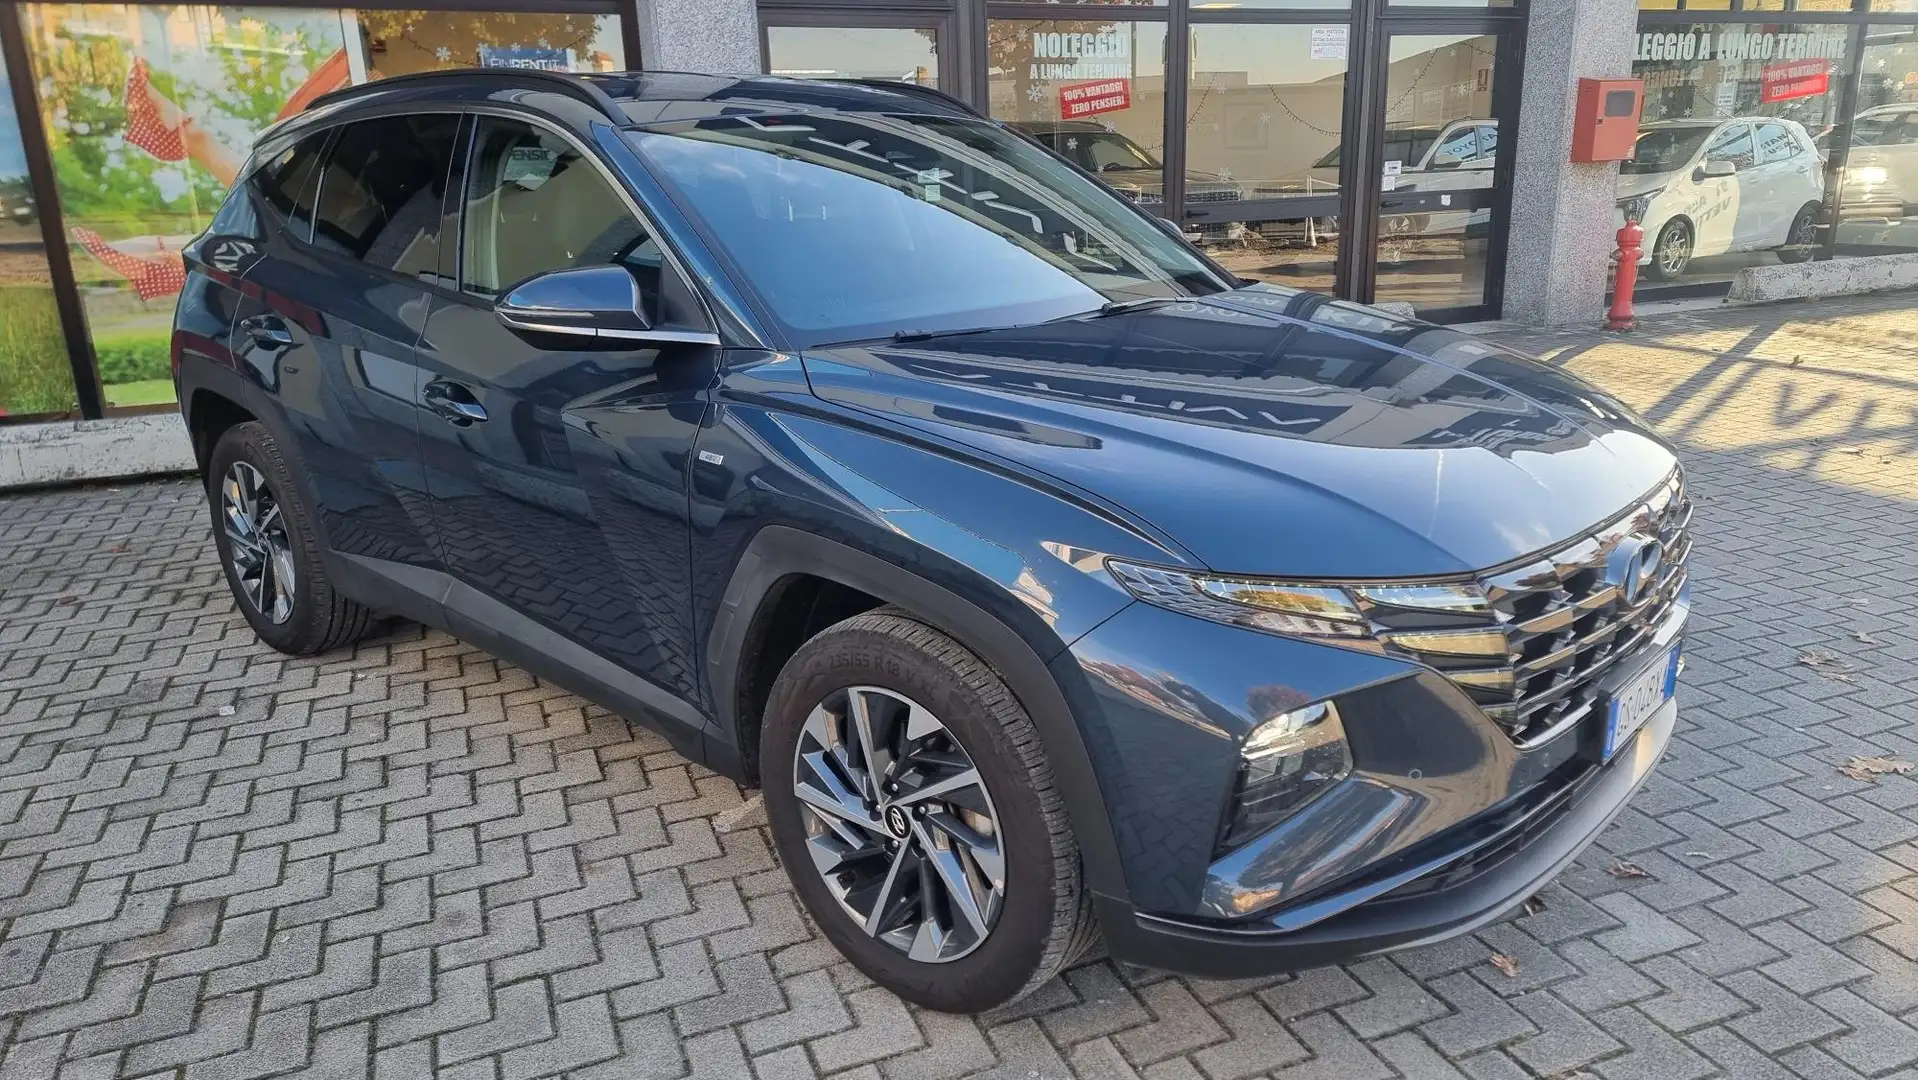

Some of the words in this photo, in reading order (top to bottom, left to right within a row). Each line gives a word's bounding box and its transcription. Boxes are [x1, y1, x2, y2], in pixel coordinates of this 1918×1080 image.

[1033, 31, 1128, 58] NOLEGGIO
[1699, 33, 1711, 60] A
[1716, 33, 1775, 60] LUNGO
[1029, 63, 1039, 79] A
[1041, 63, 1079, 79] LUNGO
[1064, 88, 1085, 101] 100%
[1085, 82, 1124, 97] VANTAGGI
[1072, 101, 1090, 114] ZERO
[1091, 95, 1125, 111] PENSIERI
